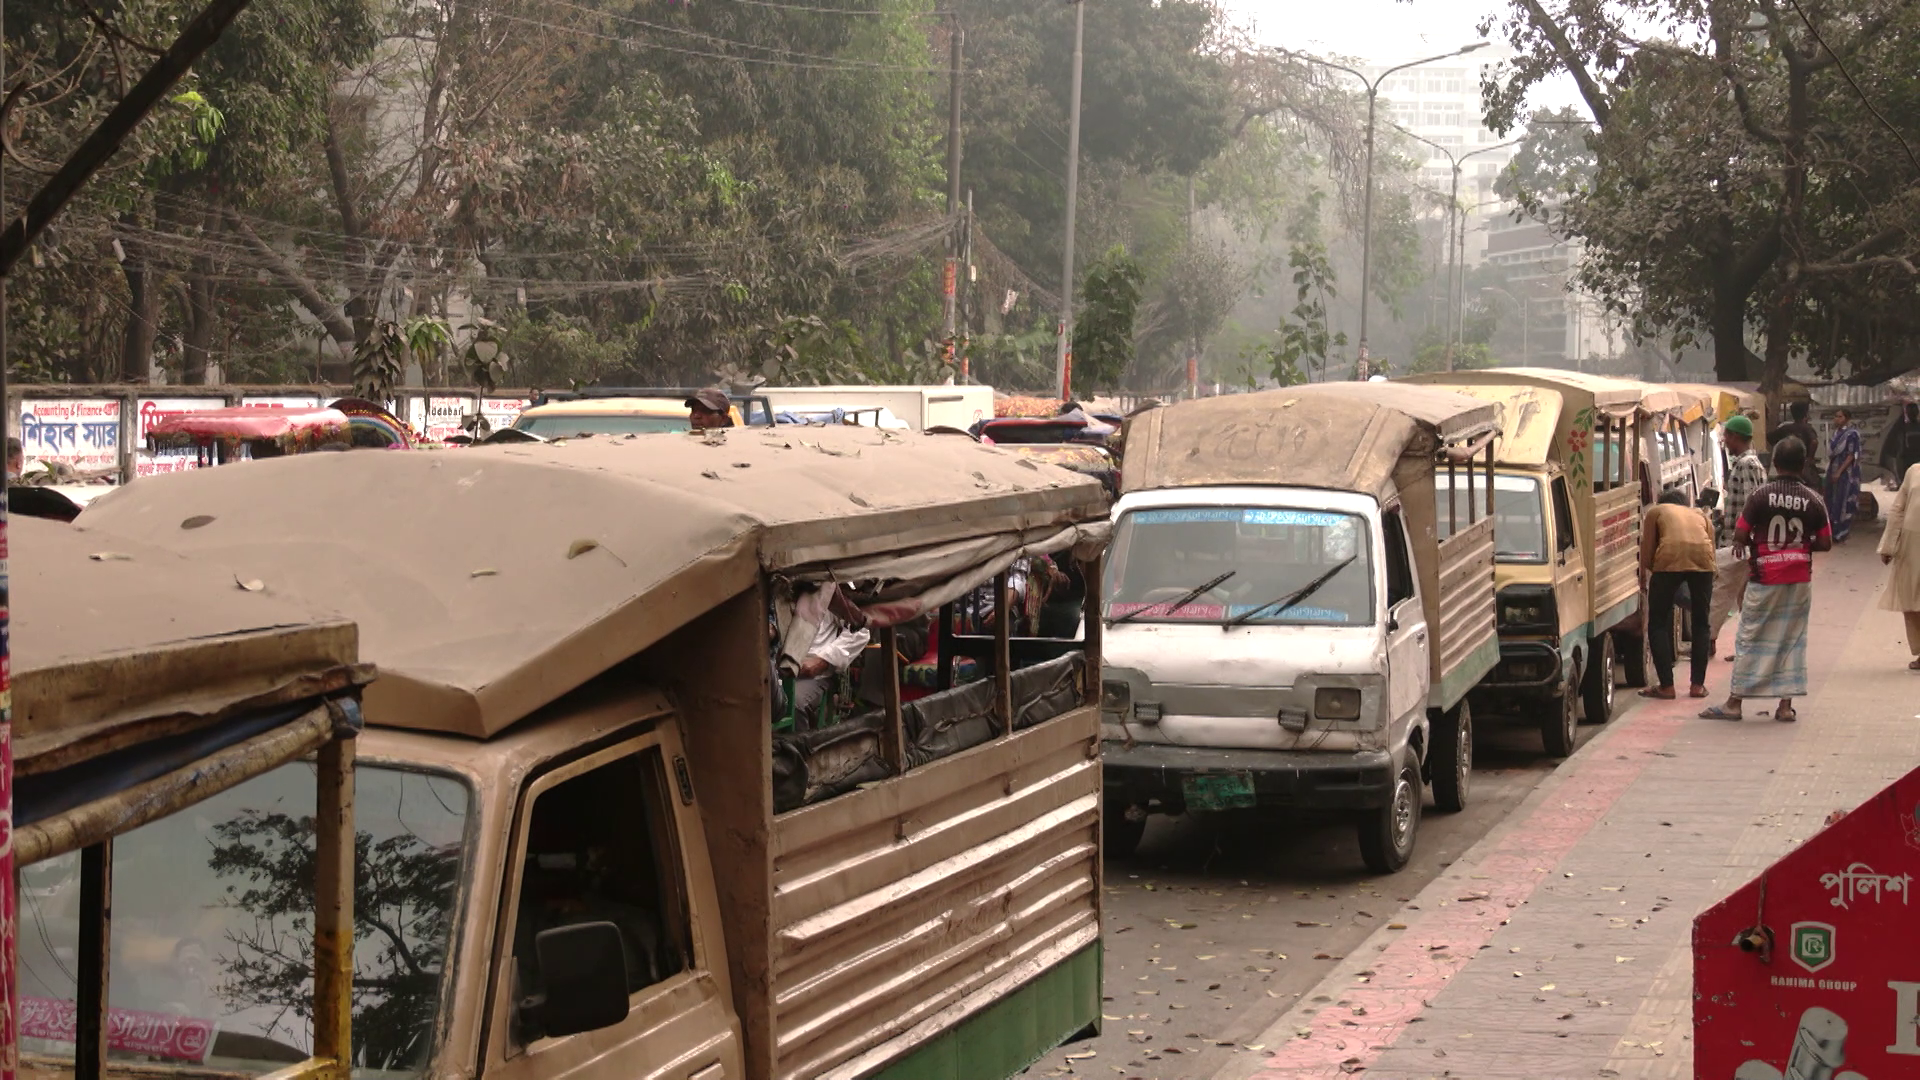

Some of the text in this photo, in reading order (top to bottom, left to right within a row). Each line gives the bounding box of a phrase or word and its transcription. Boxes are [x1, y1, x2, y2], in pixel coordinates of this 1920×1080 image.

[21, 412, 119, 455] শিহাব স্যার
[1768, 492, 1809, 512] RABBY
[1767, 515, 1804, 552] 02
[1819, 862, 1914, 910] পুলিশ
[1770, 975, 1857, 992] RAHIMA GROUP
